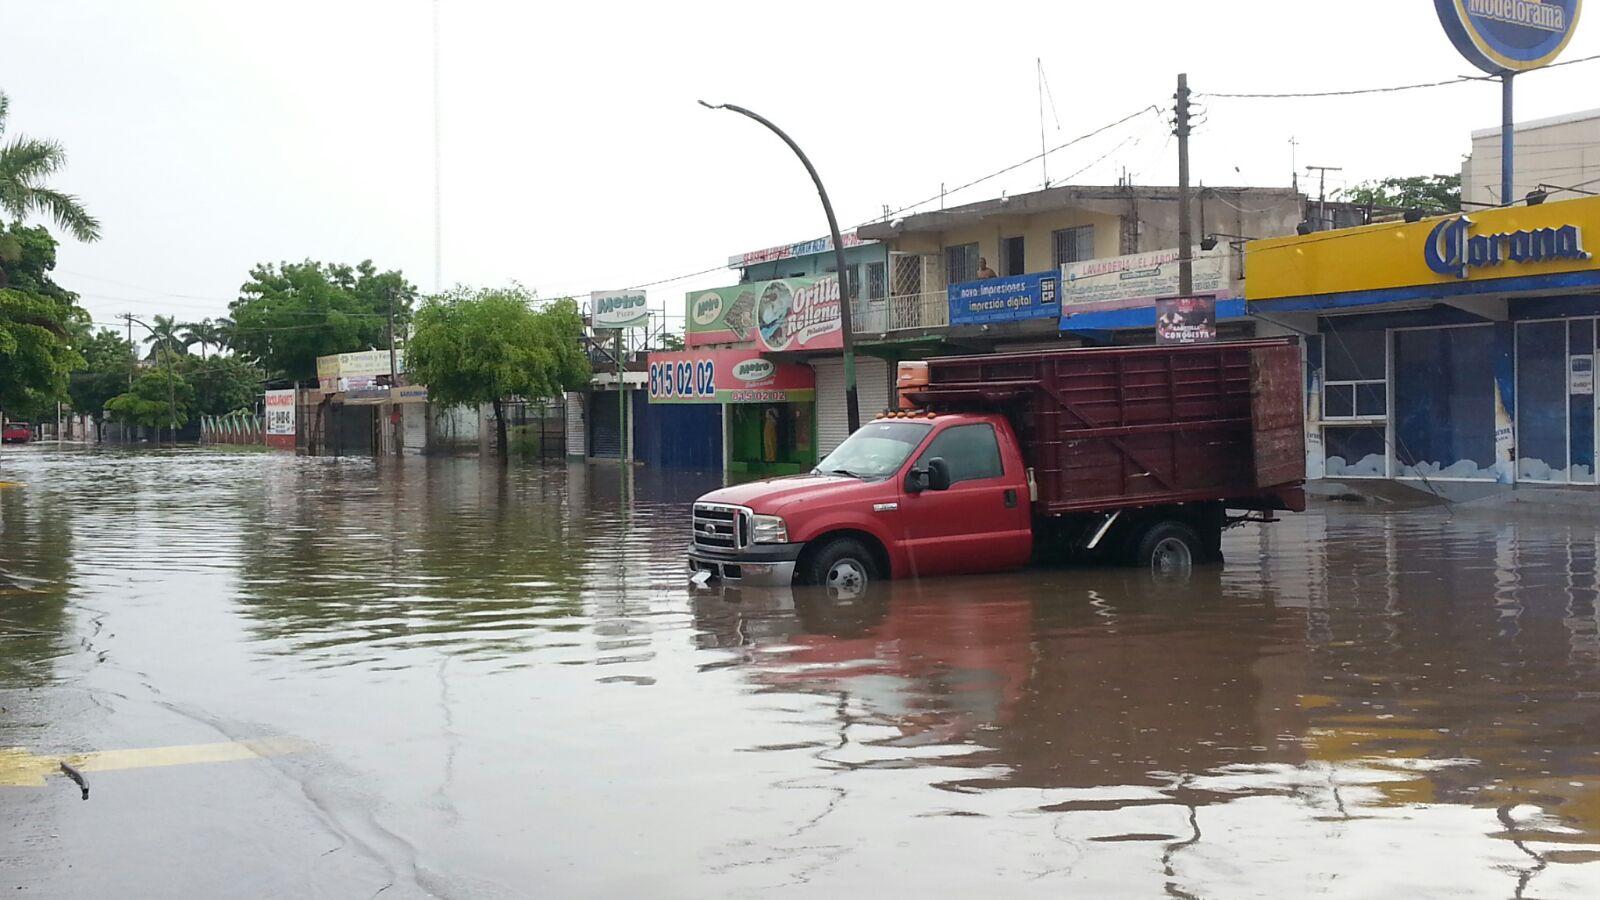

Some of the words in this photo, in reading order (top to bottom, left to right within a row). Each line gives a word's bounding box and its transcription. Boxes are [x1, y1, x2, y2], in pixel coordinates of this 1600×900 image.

[1424, 215, 1582, 279] Corona
[793, 277, 840, 313] Orilla
[980, 281, 1025, 296] impresiones
[597, 294, 646, 314] Metro
[1007, 294, 1032, 309] digital
[787, 304, 839, 336] Rellena
[1165, 331, 1209, 340] CONQUISTA
[739, 362, 770, 375] Metro
[650, 362, 673, 396] 815
[677, 361, 693, 396] 02
[697, 360, 715, 395] 02
[732, 392, 752, 400] 815
[755, 392, 768, 400] 02
[773, 391, 785, 400] 02
